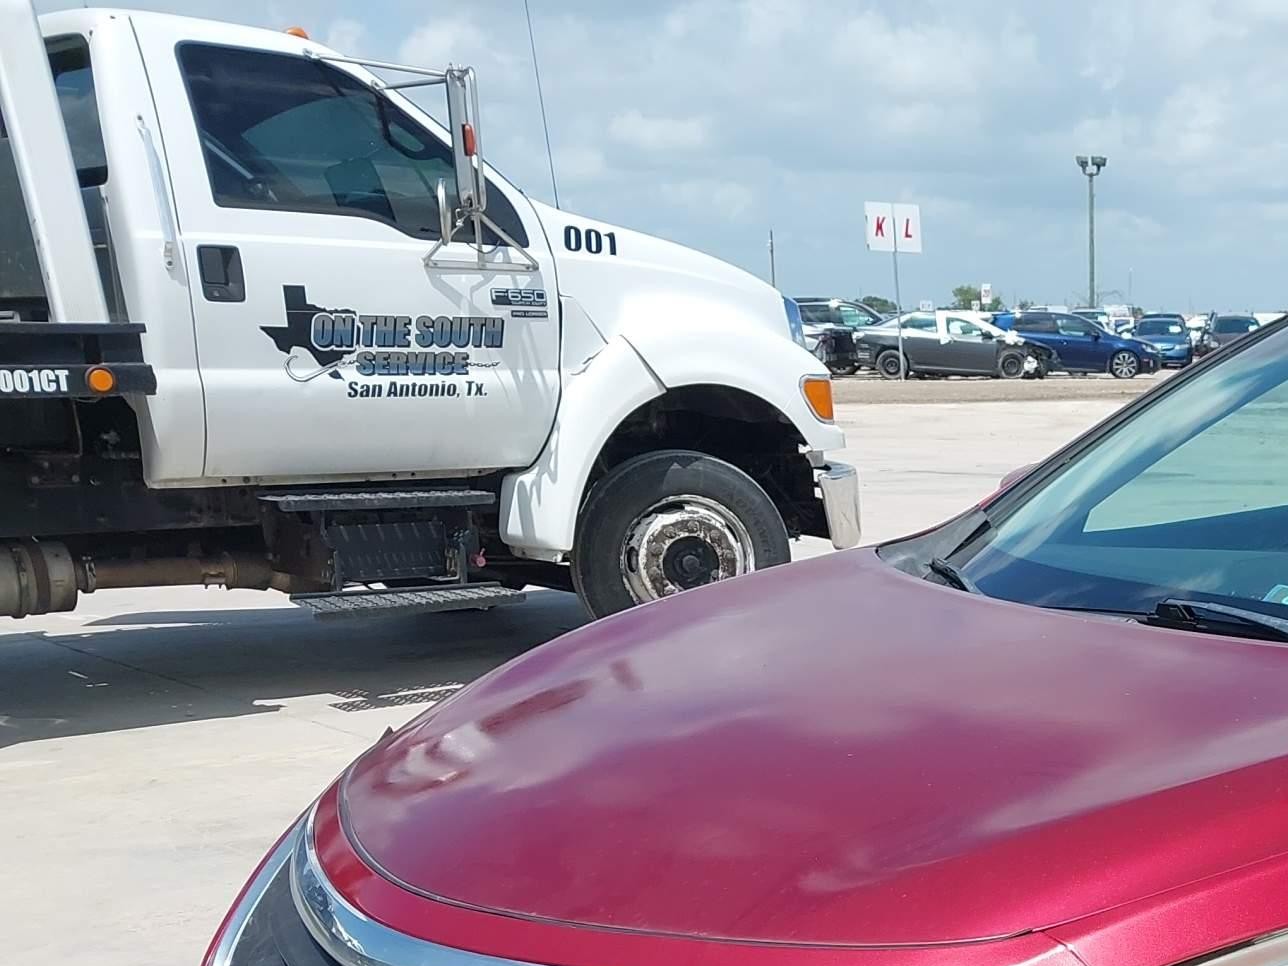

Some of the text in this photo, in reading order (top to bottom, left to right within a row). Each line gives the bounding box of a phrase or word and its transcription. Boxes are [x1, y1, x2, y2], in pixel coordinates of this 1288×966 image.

[875, 216, 913, 238] K L
[563, 225, 617, 256] 001
[311, 315, 504, 348] ON THE SOUTH
[356, 352, 470, 376] SERVICE
[347, 381, 487, 398] San Antonio, Tx.
